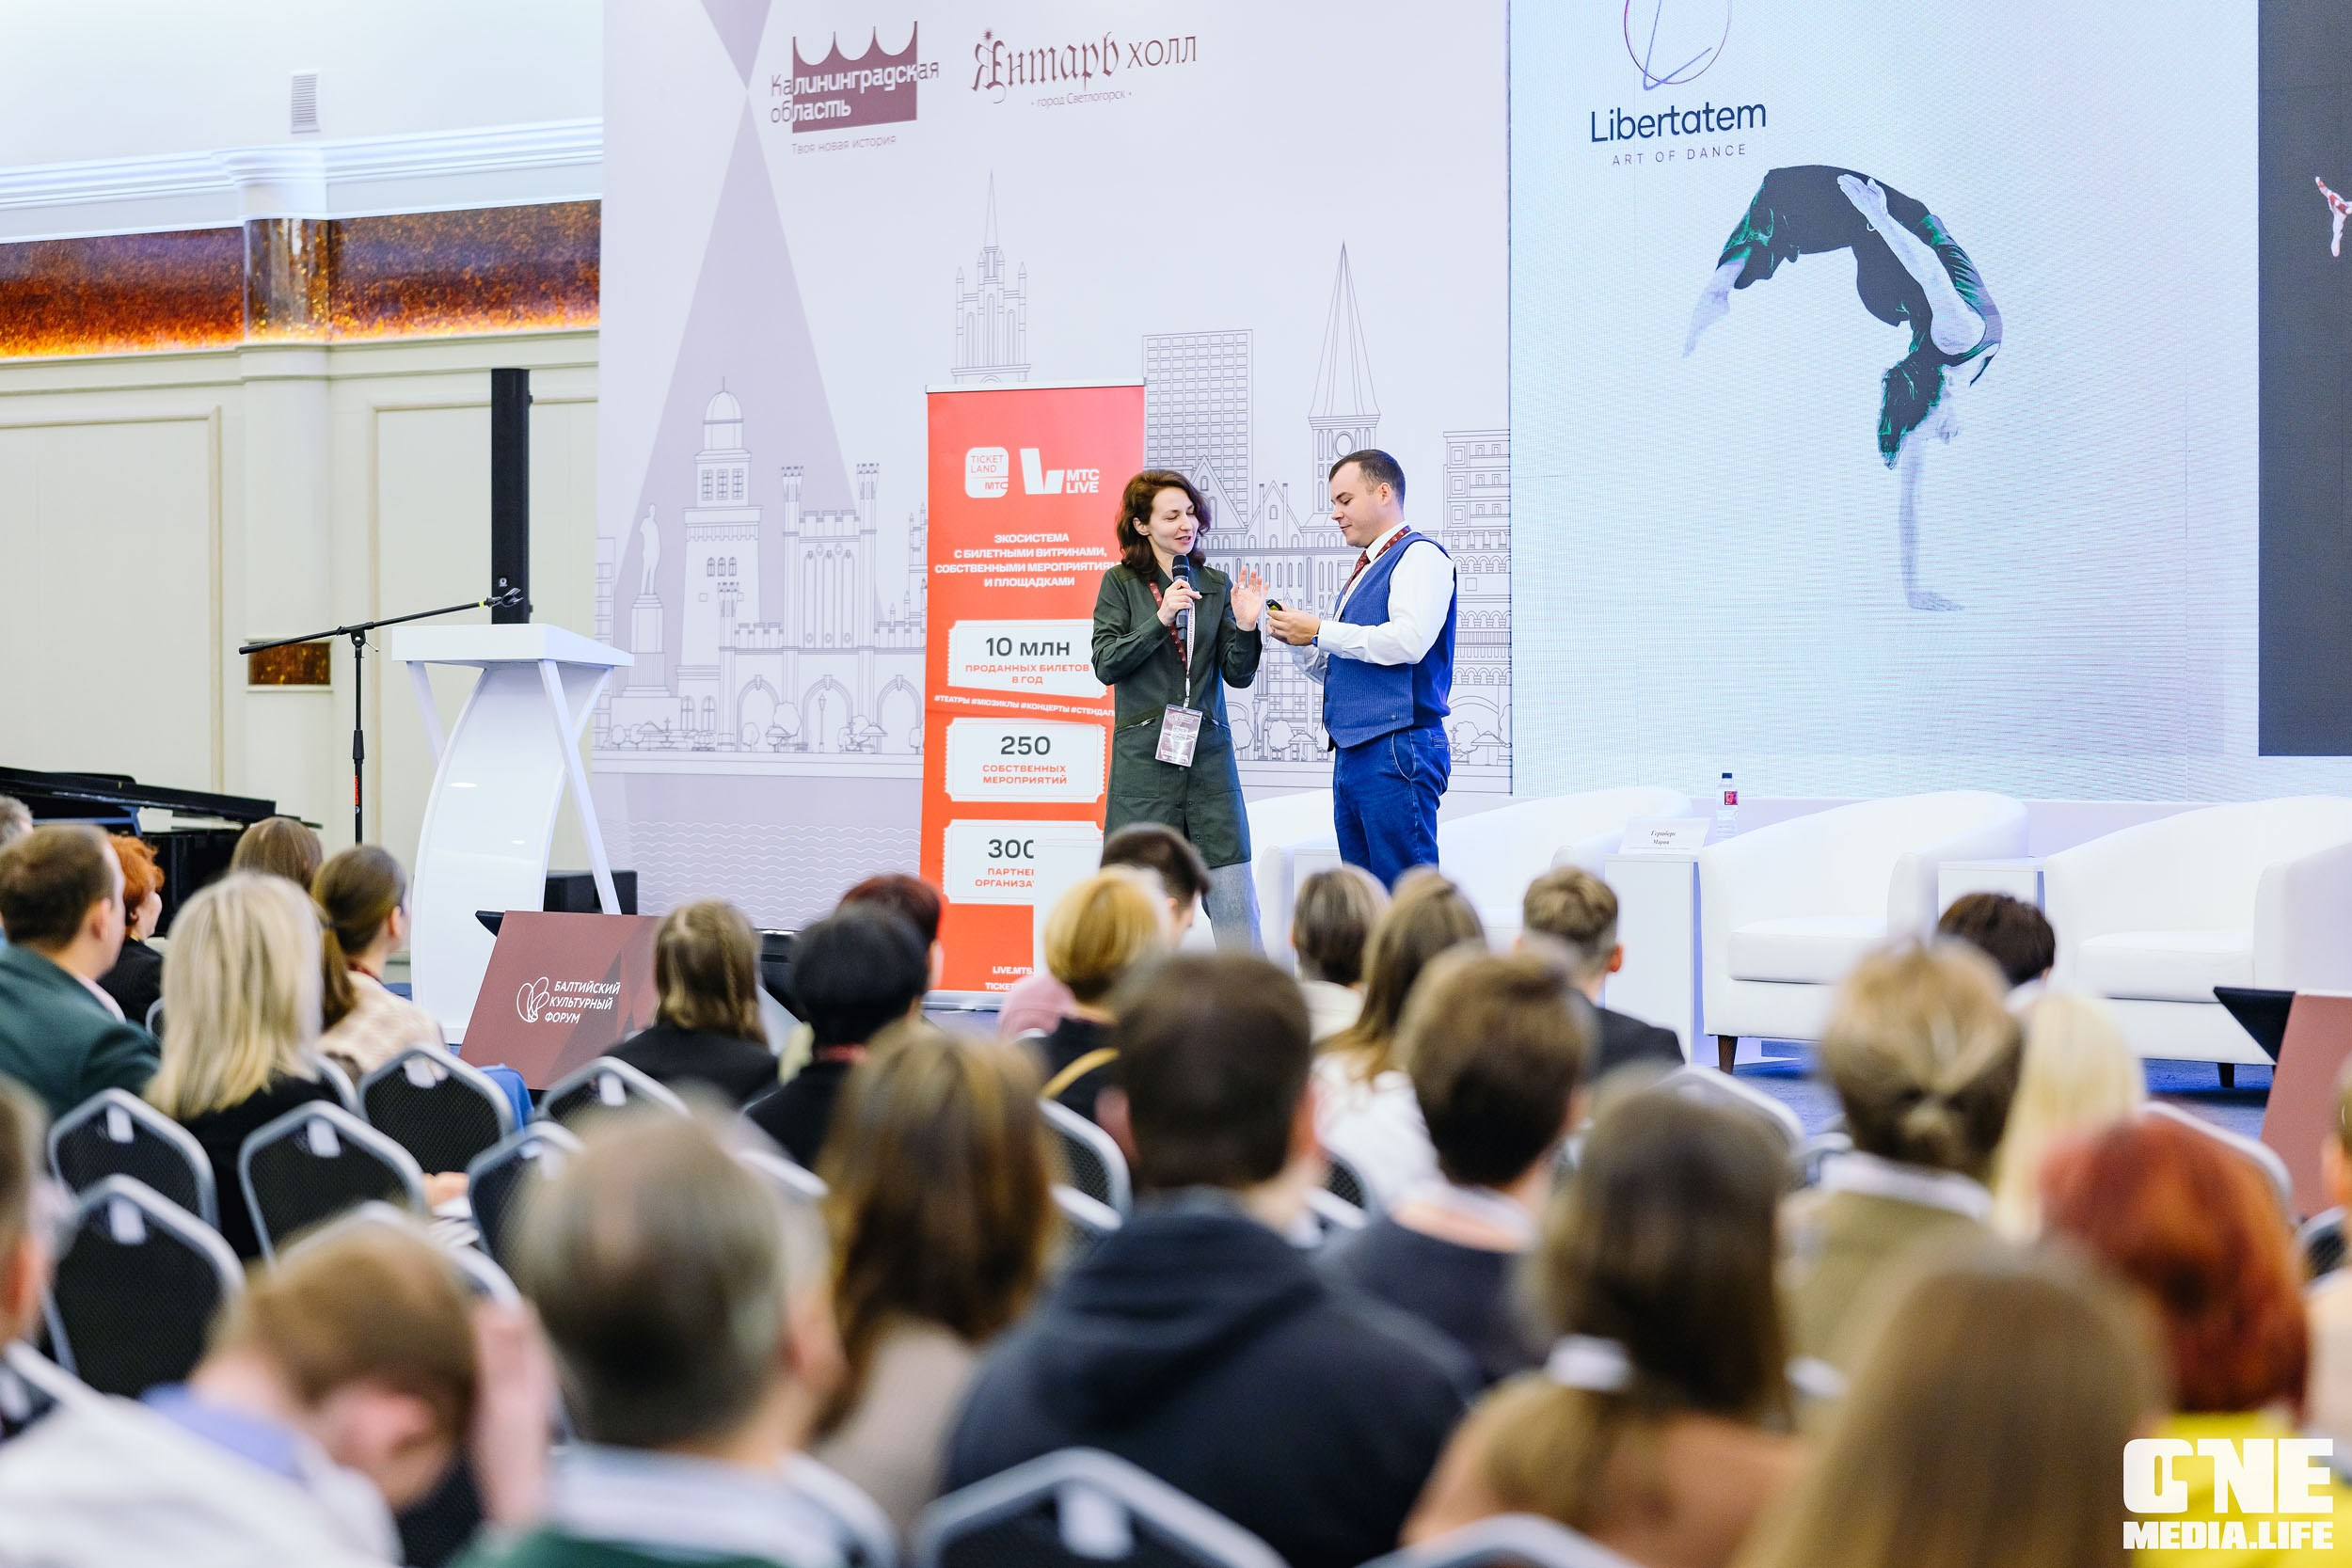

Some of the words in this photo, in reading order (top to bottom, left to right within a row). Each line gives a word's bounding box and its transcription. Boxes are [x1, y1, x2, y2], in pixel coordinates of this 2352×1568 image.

[771, 59, 939, 97] Калининградская
[1037, 95, 1065, 108] город
[1067, 89, 1126, 105] Светлогорск
[771, 97, 852, 124] область
[1592, 102, 1766, 142] Libertatem
[817, 139, 850, 153] новая
[851, 135, 897, 150] история
[1613, 153, 1644, 166] ART
[1656, 150, 1676, 163] OF
[1687, 144, 1746, 160] DANCE
[970, 454, 1004, 464] TICKET
[970, 465, 997, 473] LAND
[1066, 481, 1099, 494] LIVE
[994, 532, 1069, 544] ЭКОСИСТЕМА
[954, 549, 963, 559] С
[963, 548, 1035, 559] БИЛЕТНЫМИ
[1036, 547, 1107, 558] ВИТРИНАМИ,
[935, 563, 1027, 574] СОБСТВЕННЫМИ
[984, 578, 993, 588] И
[994, 577, 1074, 589] ПЛОЩАДКАМИ
[985, 638, 1013, 657] 10
[965, 664, 1036, 673] ПРОДАННЫХ
[1039, 664, 1089, 673] БИЛЕТОВ
[1021, 675, 1043, 685] ГОД
[934, 695, 970, 705] #ТЕАТРЫ
[971, 698, 1019, 708] #МЮЗИКЛЫ
[1020, 702, 1070, 713] #КОНЦЕРТЫ
[1000, 736, 1051, 755] 250
[982, 764, 1066, 773] СОБСТВЕННЫХ
[983, 774, 1068, 784] МЕРОПРИЯТИЙ
[987, 867, 1034, 877] ПАРТНЕ
[975, 879, 1034, 888] ОРГАНИЗА
[554, 980, 621, 995] БАЛТИЙСКИЙ
[549, 996, 613, 1010] КУЛЬТУРНЫЙ
[545, 1011, 580, 1024] ФОРУМ
